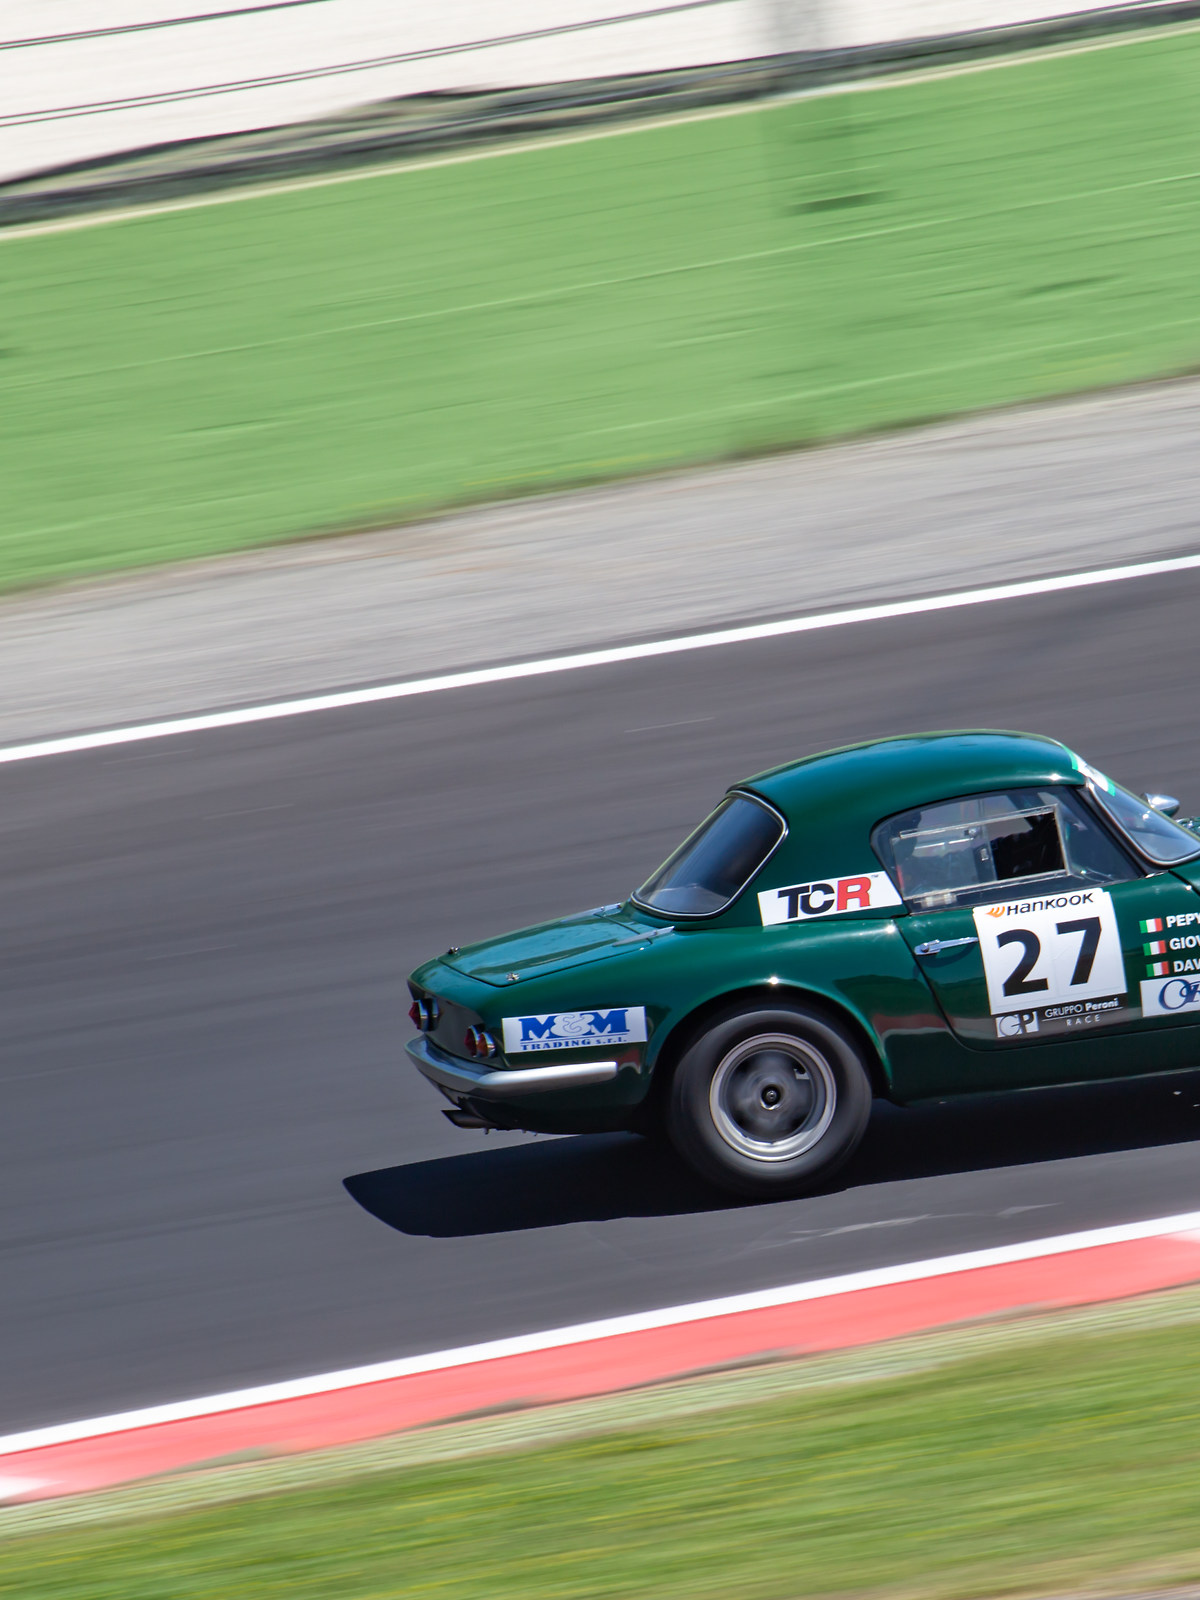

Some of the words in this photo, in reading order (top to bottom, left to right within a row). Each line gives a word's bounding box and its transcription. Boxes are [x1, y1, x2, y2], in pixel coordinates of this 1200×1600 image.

[777, 877, 871, 919] TCR
[996, 916, 1102, 997] 27
[1044, 1004, 1083, 1018] GRUPPO
[1085, 997, 1119, 1012] Peroni
[1066, 1013, 1101, 1027] RACE
[518, 1009, 630, 1041] M&M
[520, 1038, 591, 1050] TRADING
